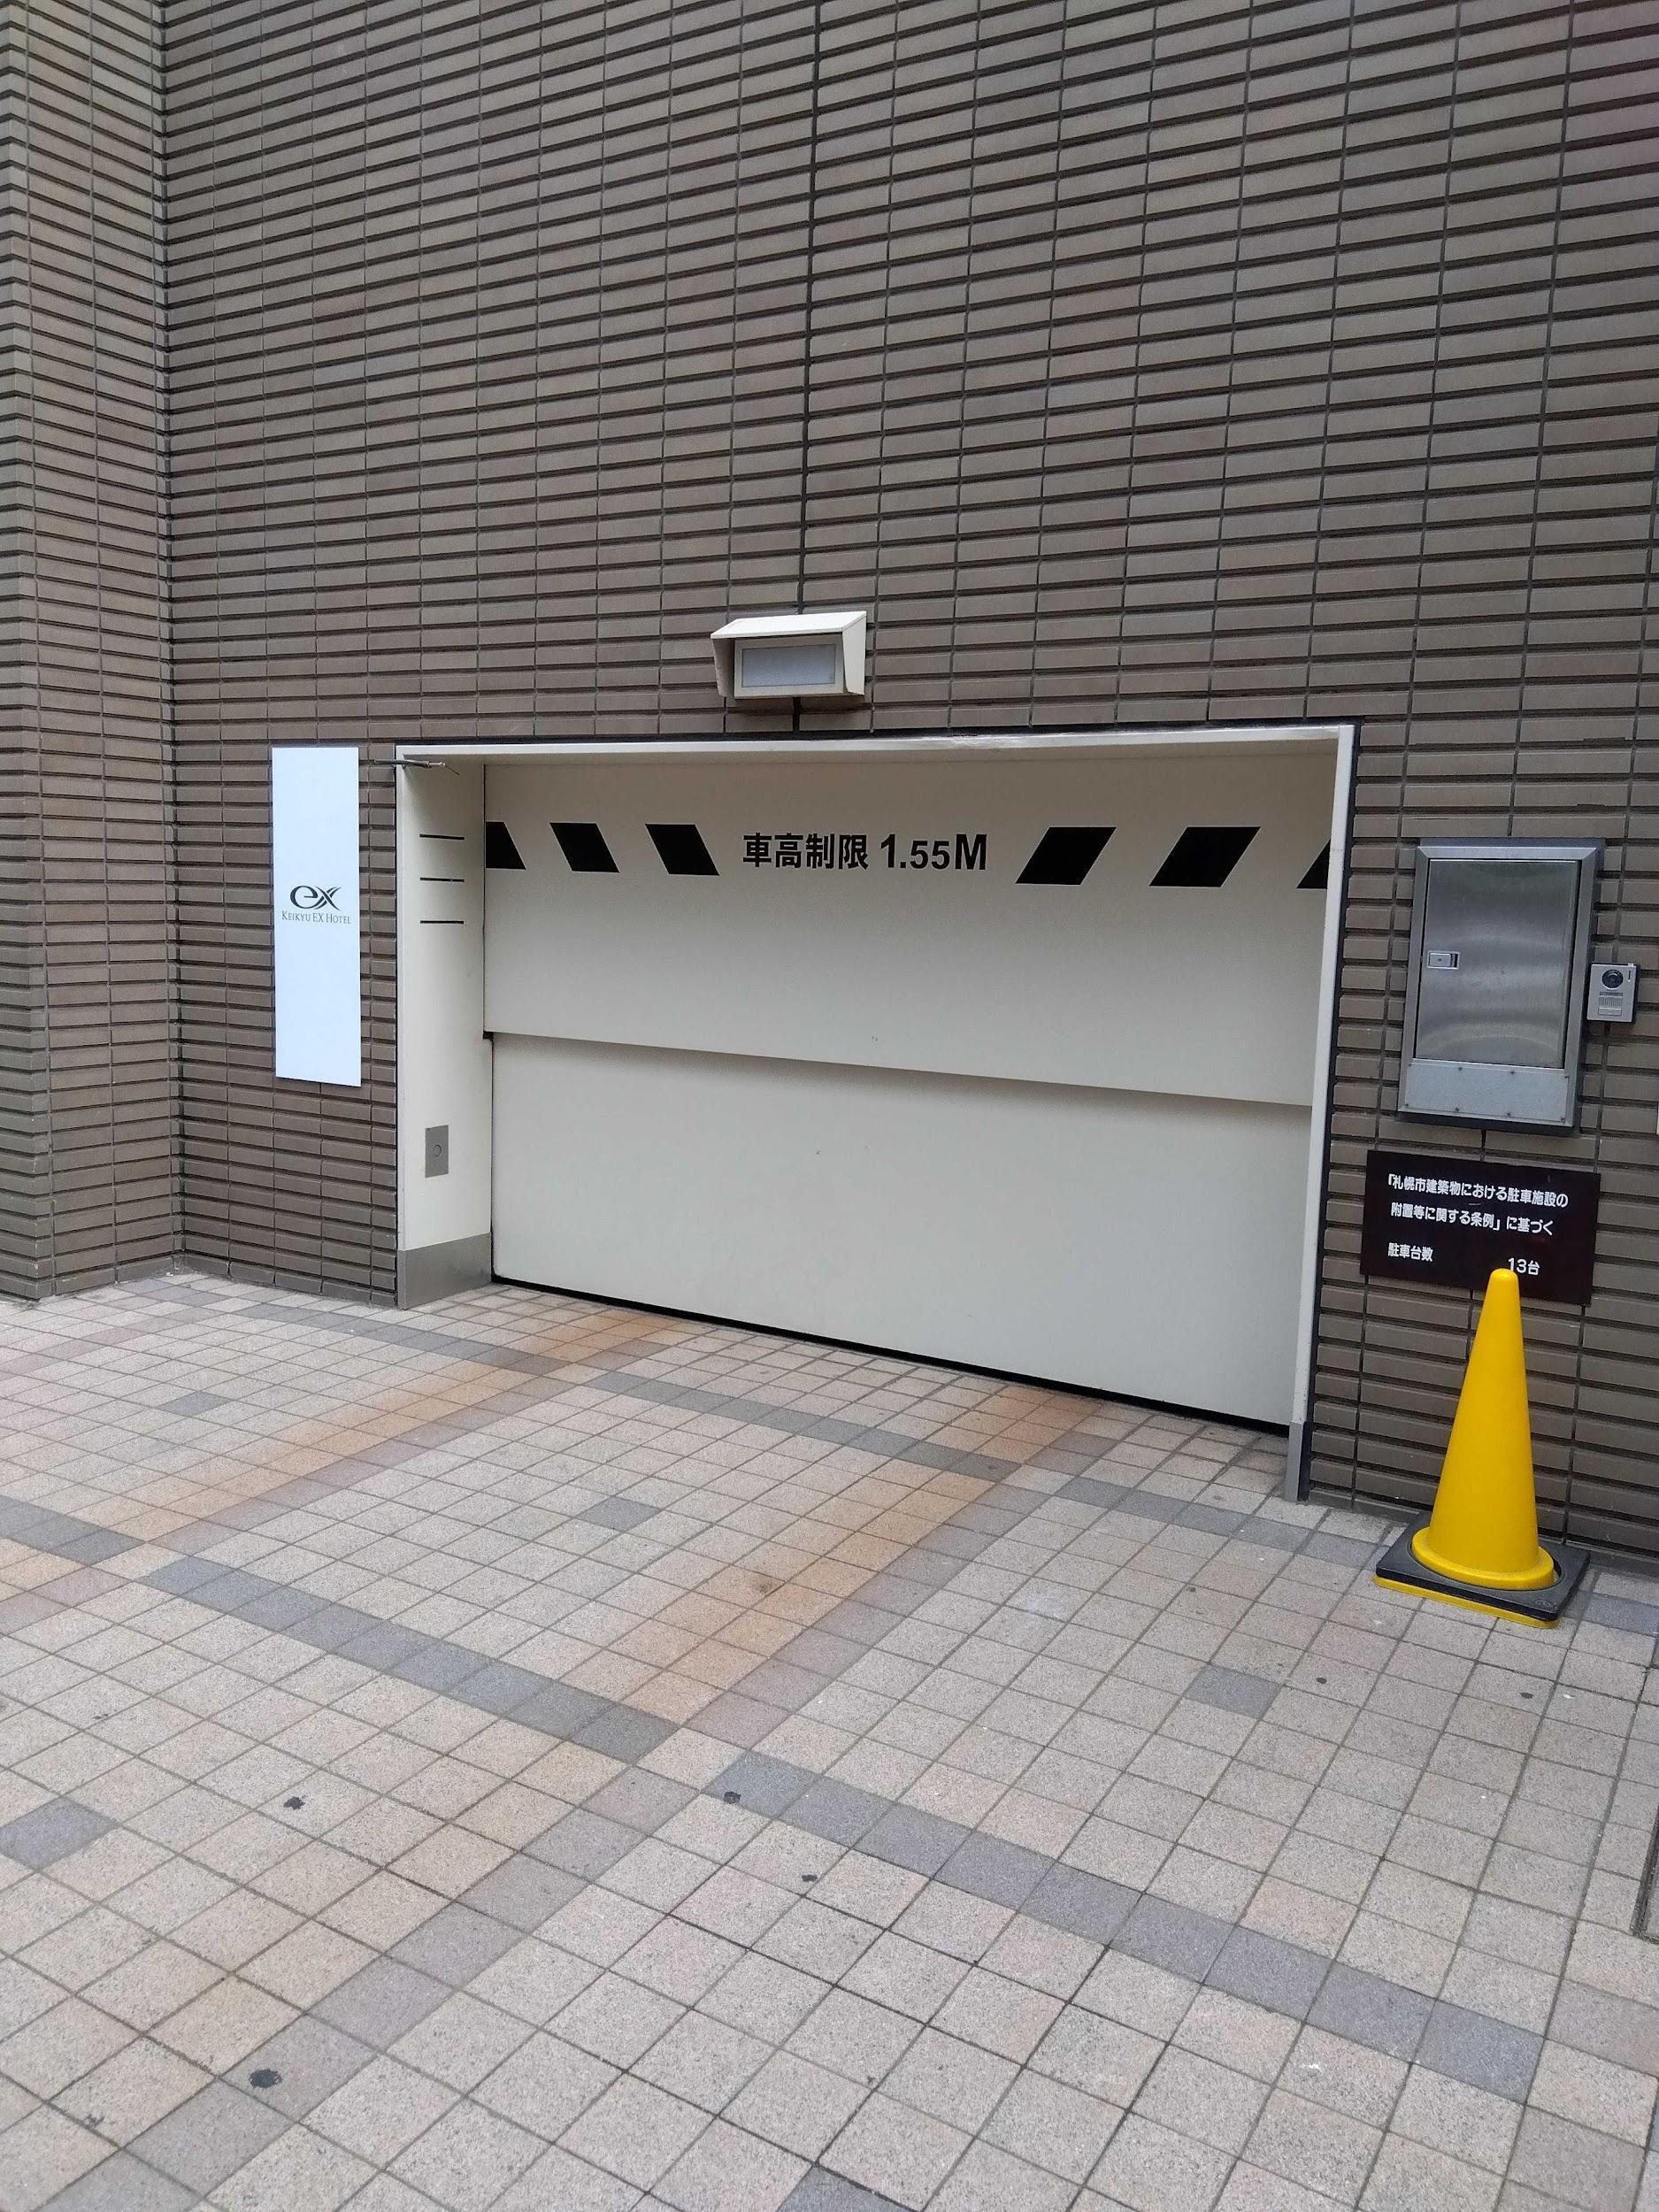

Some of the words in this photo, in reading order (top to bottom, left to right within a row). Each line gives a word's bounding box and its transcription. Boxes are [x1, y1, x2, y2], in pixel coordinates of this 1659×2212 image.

[742, 833, 869, 870] 車高制限
[880, 833, 987, 871] 1.55M
[312, 912, 324, 923] EX
[1387, 1242, 1434, 1263] 駐車台数
[1508, 1257, 1540, 1276] 13台
